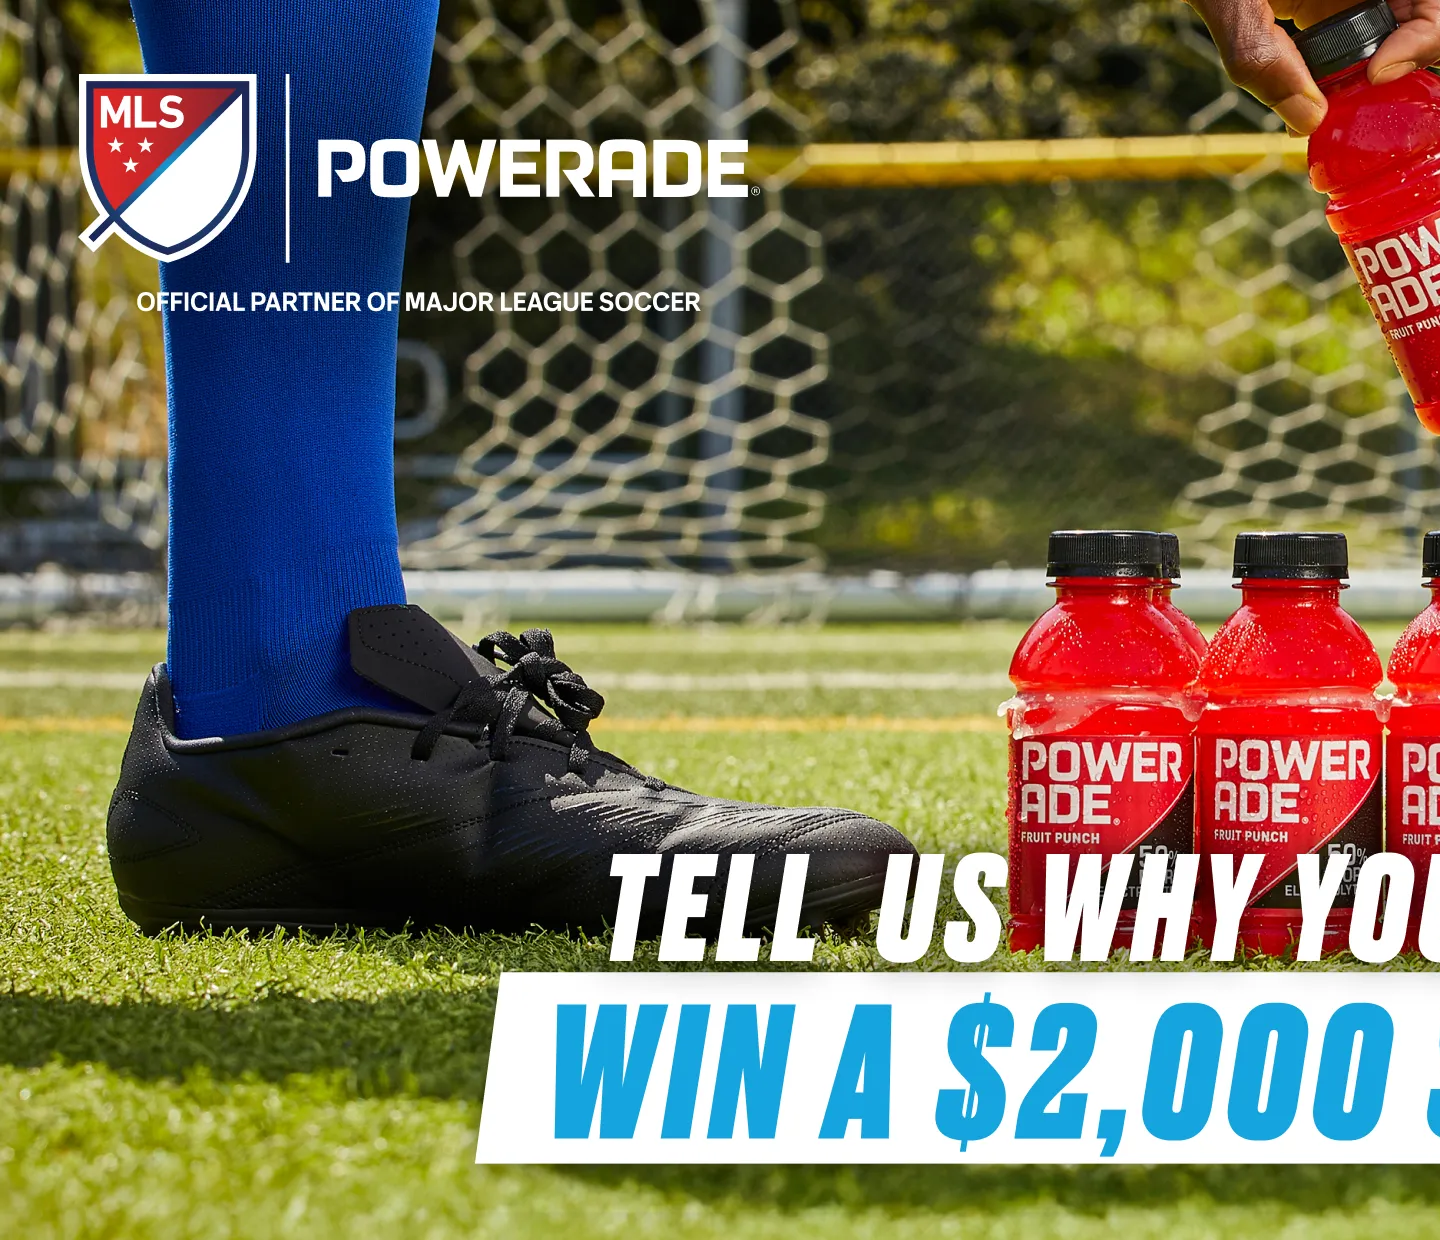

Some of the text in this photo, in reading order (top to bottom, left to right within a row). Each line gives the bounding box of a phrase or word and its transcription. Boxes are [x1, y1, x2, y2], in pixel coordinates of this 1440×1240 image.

[1390, 324, 1415, 340] FRUIT
[1021, 741, 1182, 783] POWER
[1215, 739, 1371, 781] POWER
[1021, 831, 1100, 844] FRUIT PUNCH
[1214, 829, 1289, 843] FRUIT PUNCH
[1402, 832, 1432, 845] FRUIT
